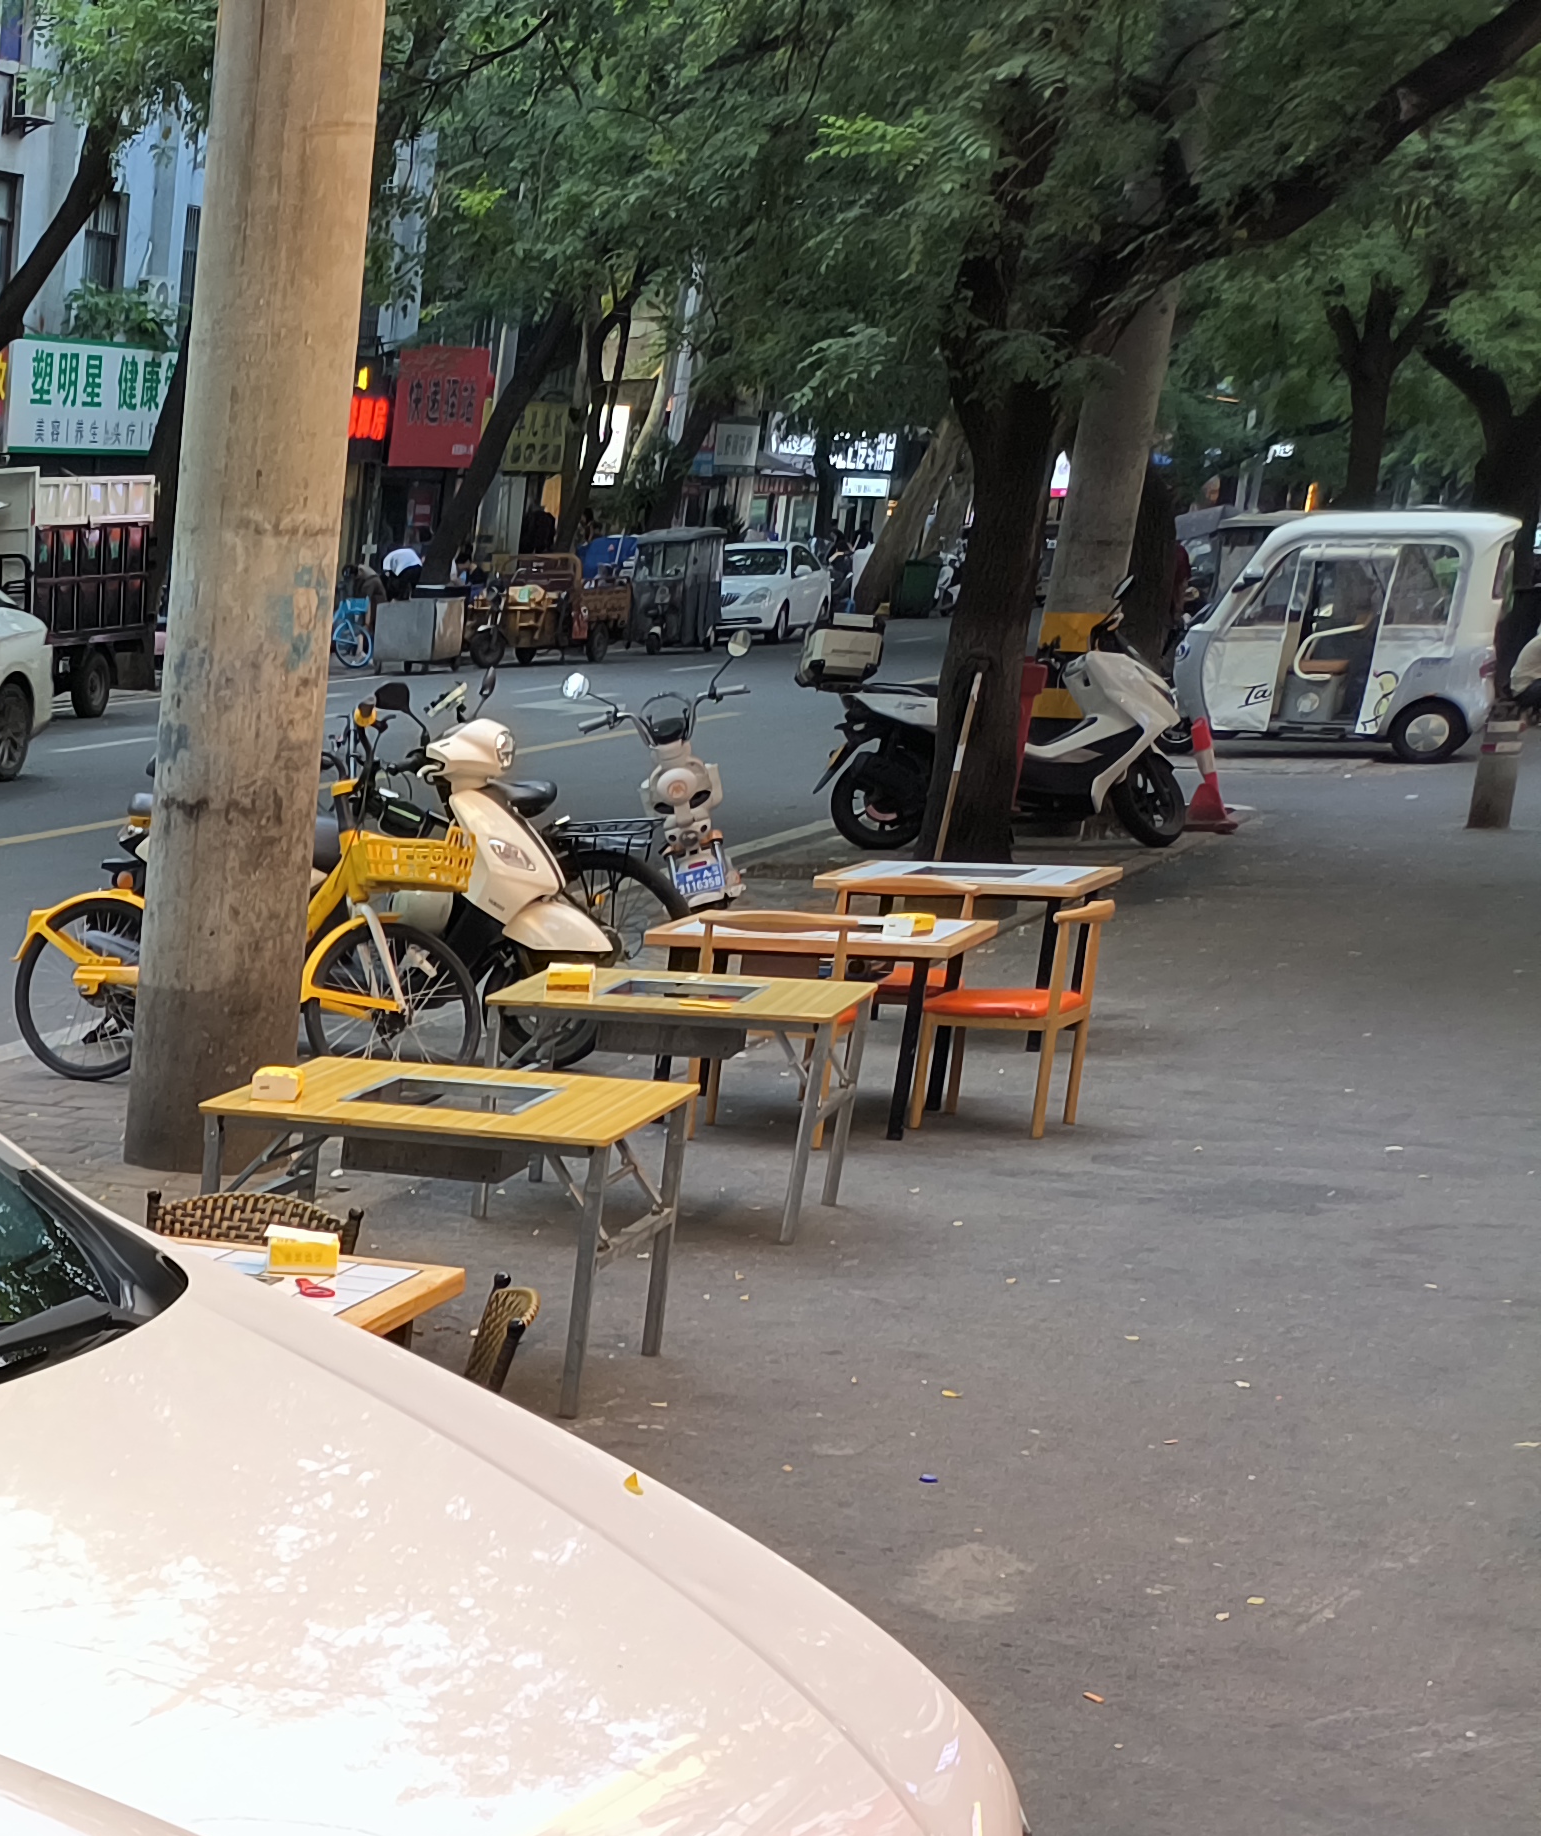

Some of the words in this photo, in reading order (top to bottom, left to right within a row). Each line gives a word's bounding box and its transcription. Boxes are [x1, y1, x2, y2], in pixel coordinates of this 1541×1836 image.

[29, 348, 103, 408] 塑明星
[407, 376, 478, 427] 快递驿站
